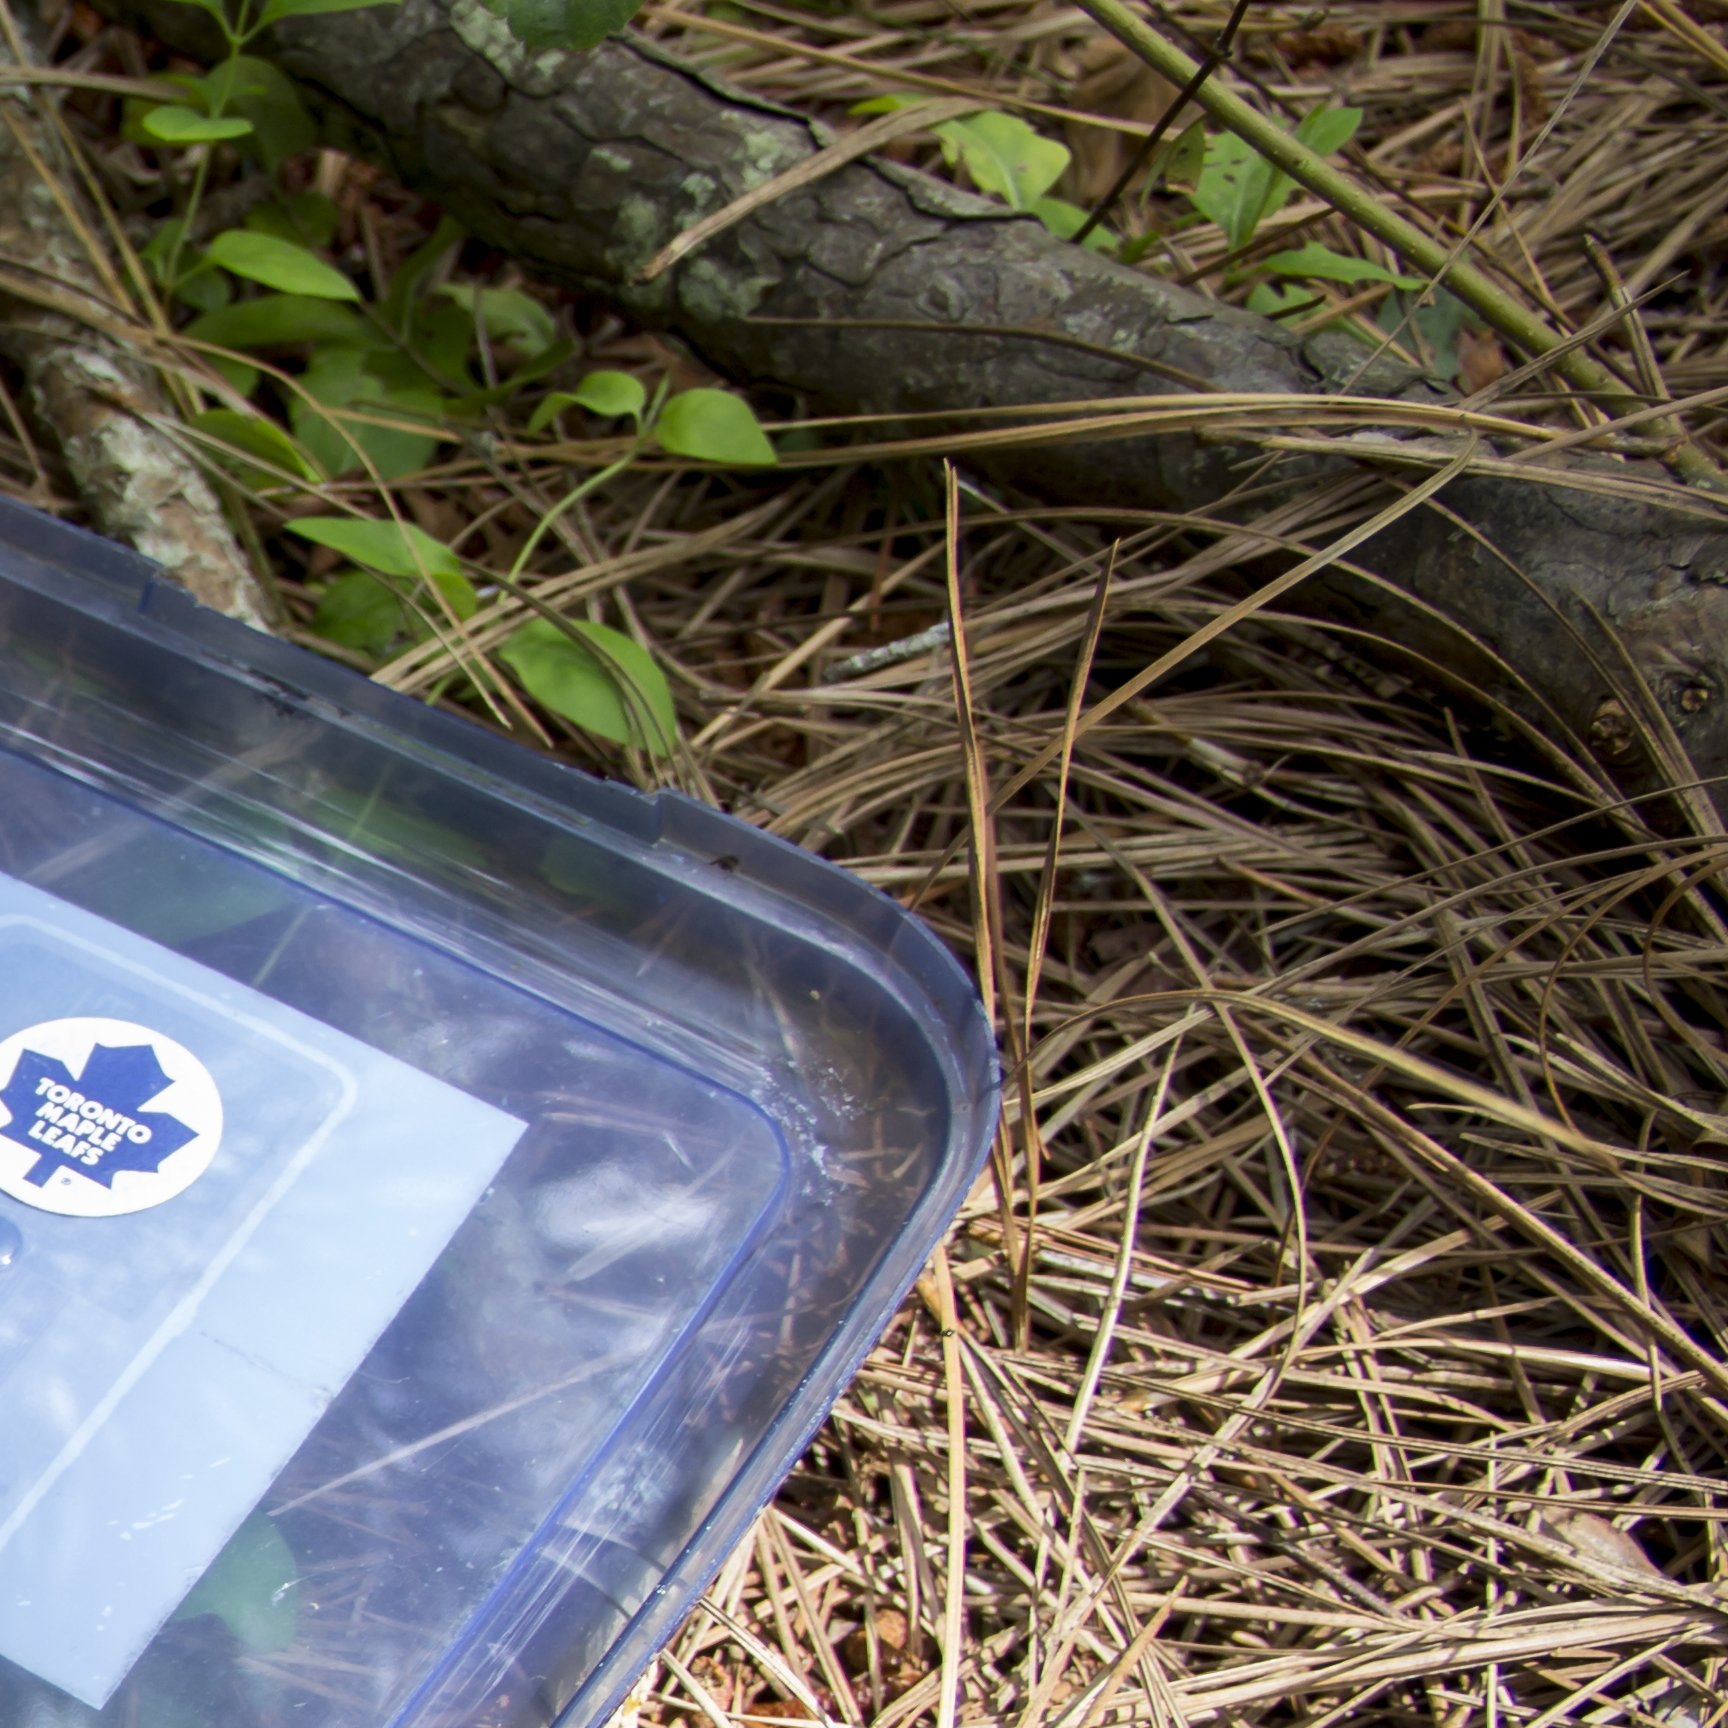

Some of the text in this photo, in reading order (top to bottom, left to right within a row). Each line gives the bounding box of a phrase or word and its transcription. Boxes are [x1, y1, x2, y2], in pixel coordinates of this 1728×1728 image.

[34, 1077, 152, 1144] TORONTO
[35, 1101, 122, 1153] MAPLE
[28, 1122, 104, 1167] LEAFS
